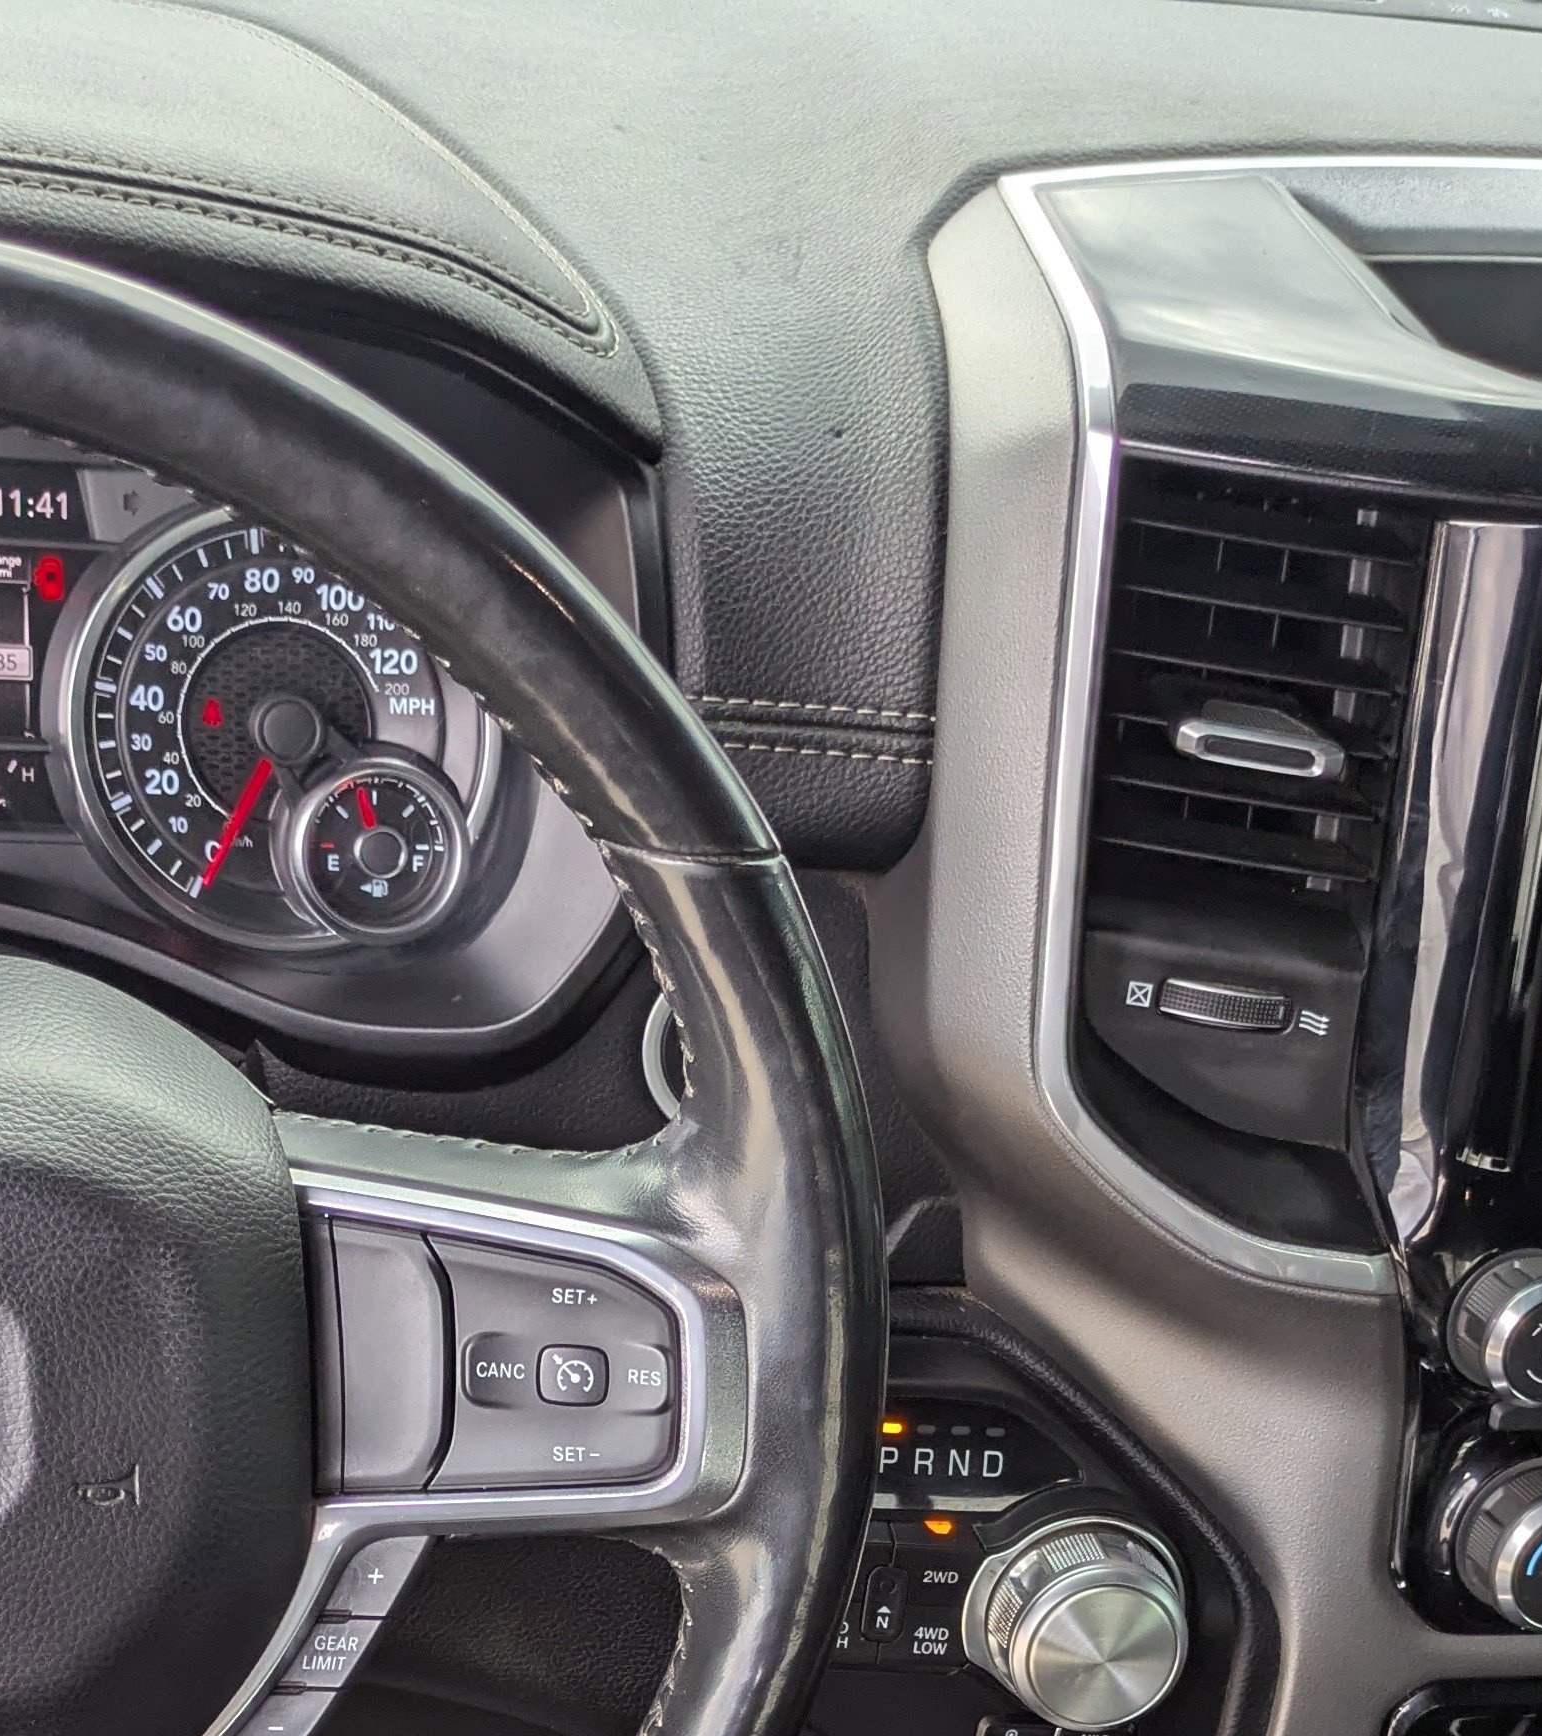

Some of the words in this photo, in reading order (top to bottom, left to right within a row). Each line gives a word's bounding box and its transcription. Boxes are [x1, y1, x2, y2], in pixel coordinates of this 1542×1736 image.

[244, 567, 280, 594] 80
[292, 567, 315, 585] 90
[208, 582, 230, 600] 70
[316, 584, 365, 612] 100
[233, 602, 258, 617] 120
[278, 601, 301, 615] 140
[166, 606, 202, 633] 60
[325, 612, 349, 627] 160
[181, 634, 205, 649] 100
[354, 633, 378, 648] 180
[144, 644, 168, 663] 50
[369, 649, 418, 676] 120
[171, 661, 187, 675] 80
[130, 684, 164, 712] 40
[384, 682, 410, 697] 200
[389, 697, 435, 717] MPH
[158, 710, 175, 724] 60
[131, 734, 152, 752] 30
[163, 751, 180, 765] 40
[22, 766, 35, 783] H
[144, 769, 180, 796] 20
[185, 793, 202, 808] 20
[168, 815, 189, 834] 10
[327, 854, 340, 872] E
[413, 856, 424, 873] F
[476, 1360, 525, 1381] CANC
[628, 1368, 662, 1387] RES
[879, 1446, 899, 1474] P
[913, 1447, 934, 1476] R
[948, 1449, 970, 1477] N
[982, 1450, 1005, 1478] D
[923, 1570, 959, 1585] 2WD
[875, 1615, 889, 1629] N
[913, 1626, 949, 1641] 4WD
[314, 1634, 358, 1652] GEAR
[912, 1641, 948, 1656] LOW
[302, 1654, 347, 1672] LIMIT
